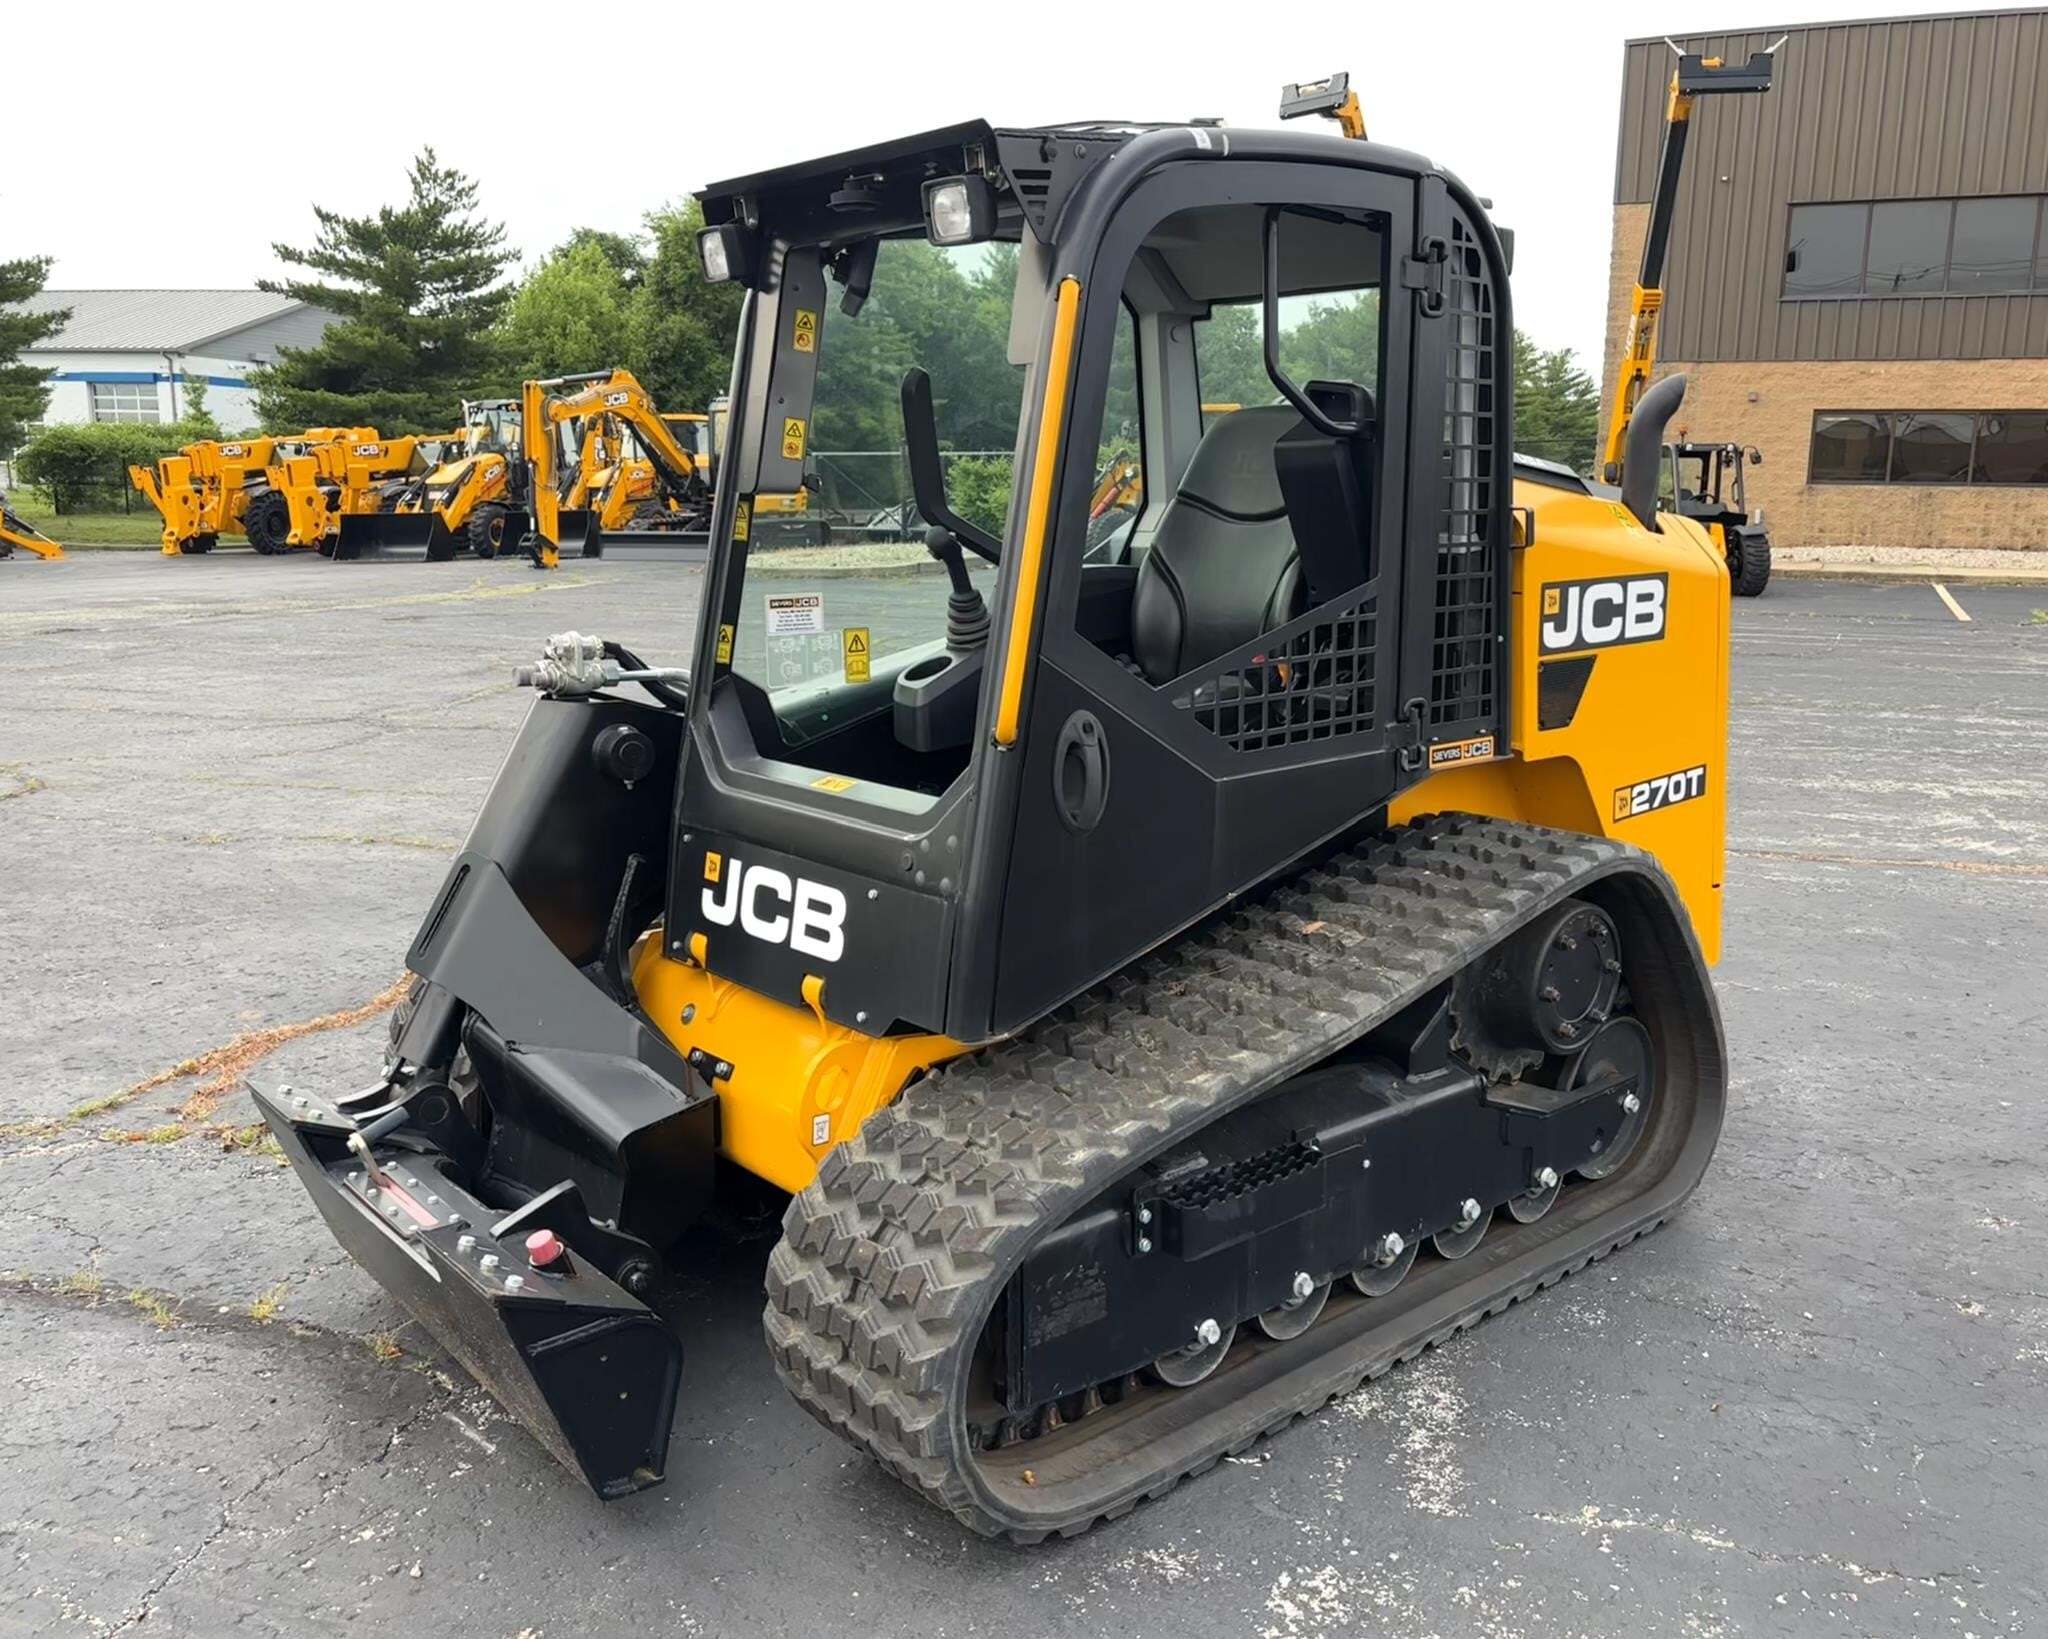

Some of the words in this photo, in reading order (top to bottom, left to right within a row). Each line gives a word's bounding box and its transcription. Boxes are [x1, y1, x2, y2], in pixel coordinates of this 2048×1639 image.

[604, 393, 628, 406] JCB
[220, 445, 242, 456] JCB
[354, 444, 379, 456] JCB
[485, 465, 500, 481] JCB
[796, 598, 817, 606] JCB
[1543, 580, 1664, 648] JCB
[1433, 749, 1460, 761] SIEVERS
[1465, 743, 1490, 757] JCB
[1631, 769, 1704, 813] 270T
[702, 858, 846, 962] JCB
